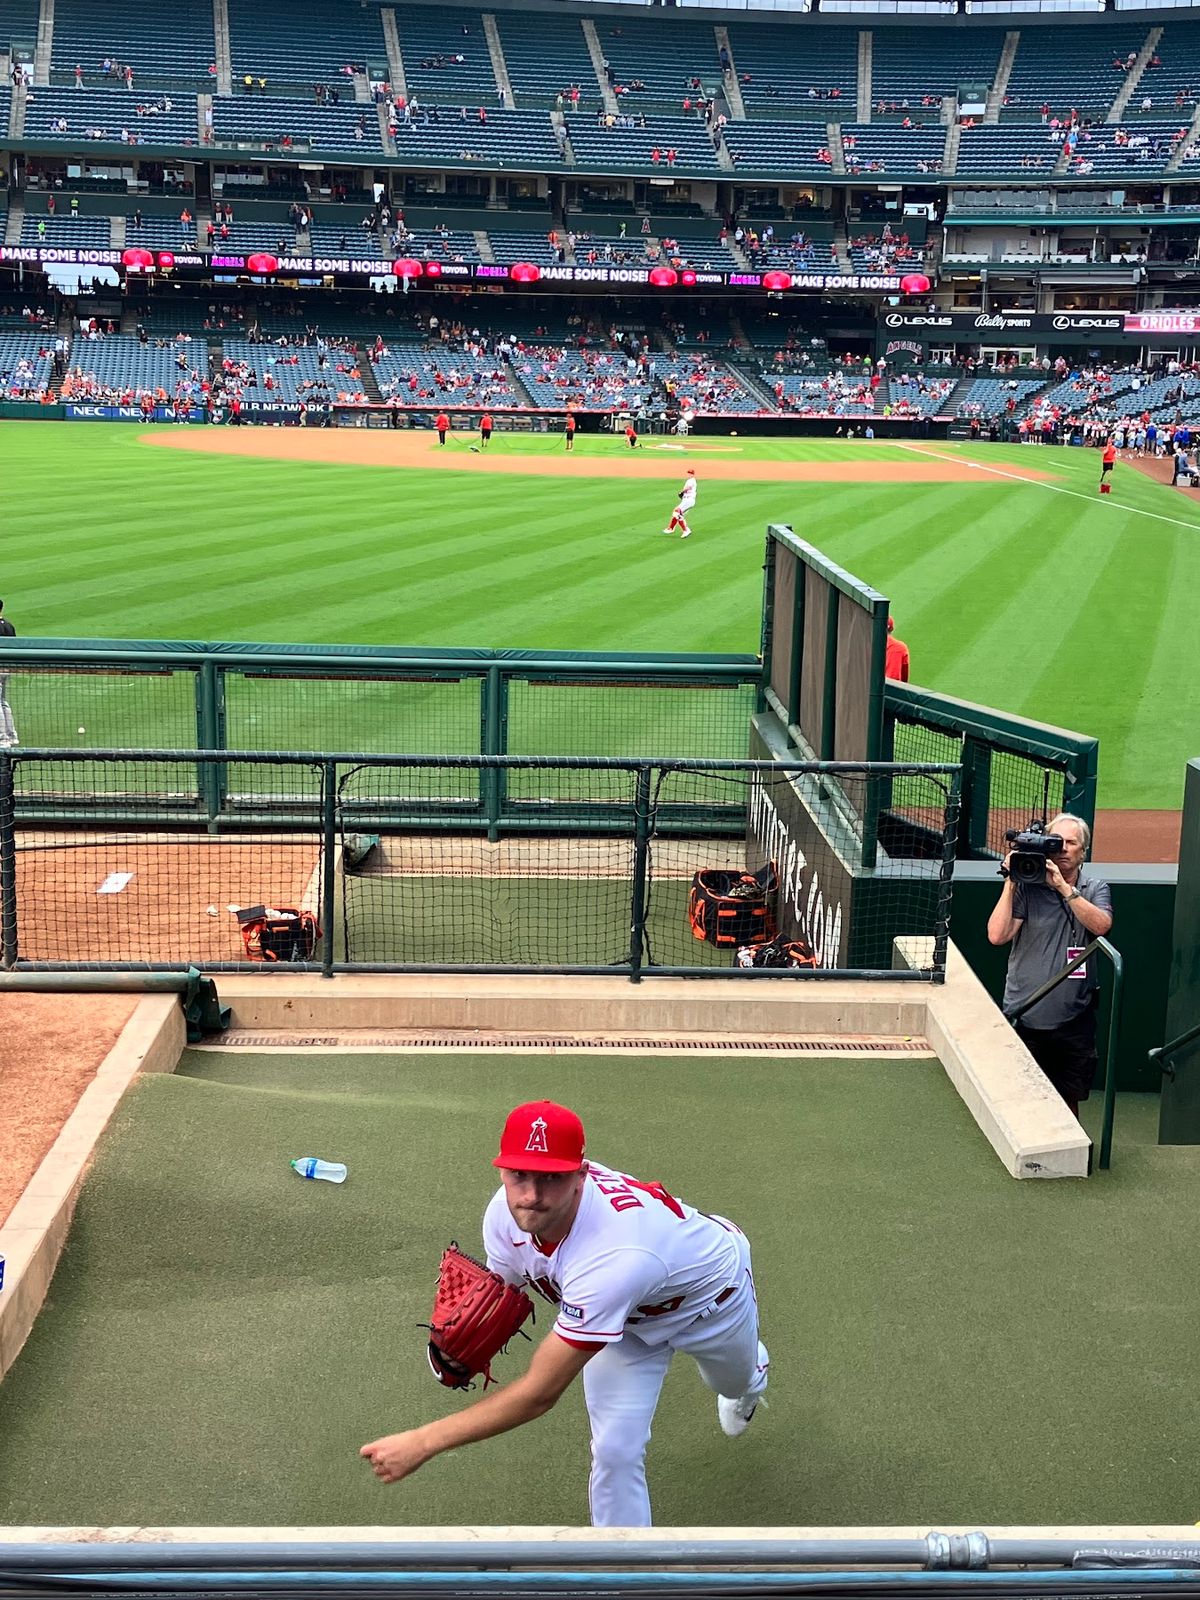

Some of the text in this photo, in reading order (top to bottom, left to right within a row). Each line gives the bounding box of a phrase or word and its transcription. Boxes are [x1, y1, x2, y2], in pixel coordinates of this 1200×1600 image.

[1, 247, 122, 263] MAKE SOME NOISE!
[174, 255, 203, 265] TOYOTA
[211, 254, 245, 267] ANGELS
[278, 257, 392, 273] MAKE SOME NOISE!
[441, 266, 469, 274] TOYOTA
[539, 267, 649, 282] MAKE SOME NOISE!
[695, 274, 722, 282] TOYOTA
[729, 273, 761, 285] ANGELS
[791, 275, 900, 289] MAKE SOME NOISE!
[904, 316, 953, 326] LEXUS
[974, 313, 1031, 330] Bally SPORTS
[1071, 319, 1120, 328] LEXUS
[1140, 316, 1196, 329] ORIOLES
[885, 340, 923, 356] ANGELS
[73, 406, 105, 416] NEC
[119, 407, 149, 417] NE
[525, 1116, 548, 1152] A
